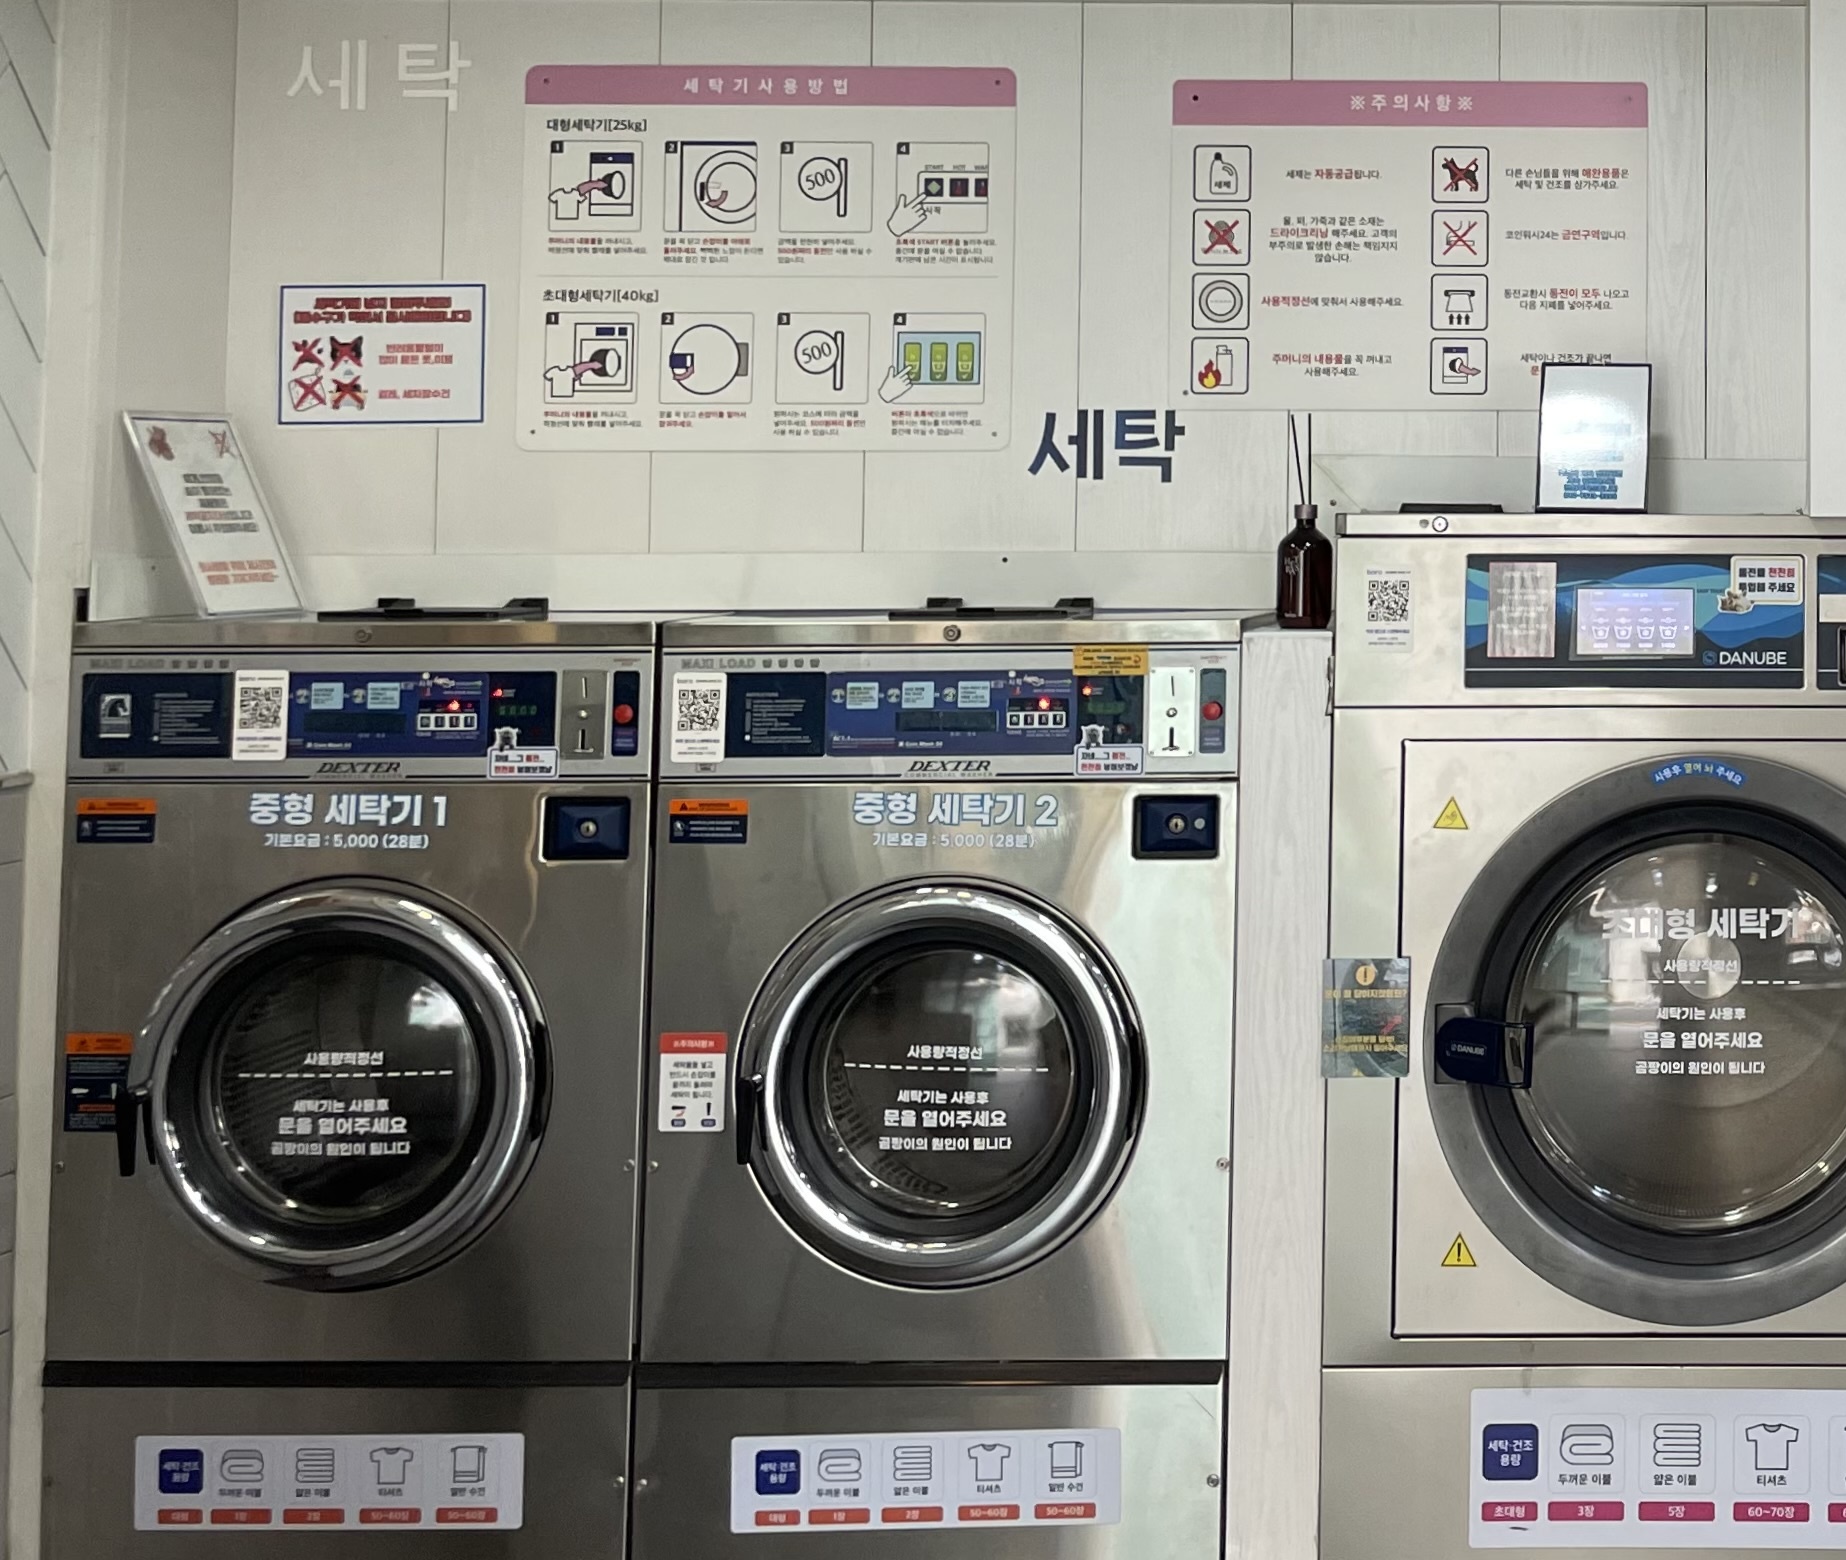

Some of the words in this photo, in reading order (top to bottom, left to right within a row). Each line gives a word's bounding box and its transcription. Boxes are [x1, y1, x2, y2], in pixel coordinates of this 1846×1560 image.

[286, 39, 473, 112] 세탁
[546, 117, 648, 133] 대형세탁기[25kg]
[805, 169, 836, 191] 500
[1286, 170, 1312, 180] 세제는
[1270, 227, 1329, 239] 드라이크리닝
[543, 289, 660, 303] 초대형세탁기[40kg]
[1504, 289, 1547, 299] 동전교환시
[1581, 288, 1601, 299] 모두
[1603, 289, 1630, 299] 나오고
[801, 341, 833, 363] 500
[1272, 353, 1312, 365] 주머니의
[1520, 353, 1555, 363] 세탁이나
[1028, 409, 1186, 483] 세탁
[1768, 582, 1796, 593] 주세요
[719, 658, 756, 669] LOAD
[1719, 651, 1787, 666] DANUBE
[316, 762, 401, 774] DEXTER
[907, 760, 992, 772] DEXTER
[1715, 765, 1743, 785] 주세요
[250, 792, 315, 826] 중형
[324, 793, 424, 827] 세탁기
[432, 795, 448, 827] 1
[852, 791, 918, 827] 중형
[928, 792, 1027, 827] 세탁기
[1034, 794, 1059, 827] 2
[264, 833, 322, 848] 기본요금
[333, 833, 379, 849] 5,000
[383, 833, 430, 849] (28분)
[872, 832, 929, 847] 기본요금
[989, 833, 1036, 850] (28분)
[1707, 908, 1800, 939] 세탁기
[1664, 959, 1738, 973] 사용량적정선
[1656, 1007, 1706, 1021] 세탁기는
[1709, 1007, 1746, 1021] 사용후
[1643, 1032, 1676, 1049] 문을
[1681, 1032, 1764, 1049] 열어주세요
[304, 1051, 384, 1066] 사용량적정선
[906, 1045, 983, 1060] 사용량적정선
[1635, 1061, 1685, 1075] 곰팡이의
[1688, 1061, 1725, 1075] 원인이
[1728, 1061, 1766, 1075] 됩니다
[896, 1090, 947, 1104] 세탁기는
[950, 1091, 990, 1104] 사용후
[293, 1099, 345, 1113] 세탁기는
[349, 1099, 390, 1113] 사용후
[883, 1109, 917, 1128] 문을
[922, 1110, 1007, 1128] 열어주세요
[278, 1117, 312, 1135] 문을
[318, 1117, 408, 1135] 열어주세요
[878, 1136, 928, 1150] 곰팡이의
[932, 1137, 969, 1151] 원인이
[973, 1137, 1013, 1151] 됩니다
[1500, 1453, 1521, 1467] 용량
[1557, 1473, 1589, 1486] 두꺼운
[1591, 1473, 1612, 1486] 이불
[1653, 1473, 1674, 1486] 얇은
[1677, 1473, 1698, 1486] 이불
[1756, 1474, 1788, 1487] 티셔츠
[977, 1484, 1002, 1493] 티셔츠
[1067, 1483, 1084, 1492] 수건
[1494, 1505, 1526, 1518] 초대형
[1577, 1505, 1595, 1518] 3장
[1668, 1505, 1686, 1518] 5장
[1747, 1506, 1795, 1519] 60~70장
